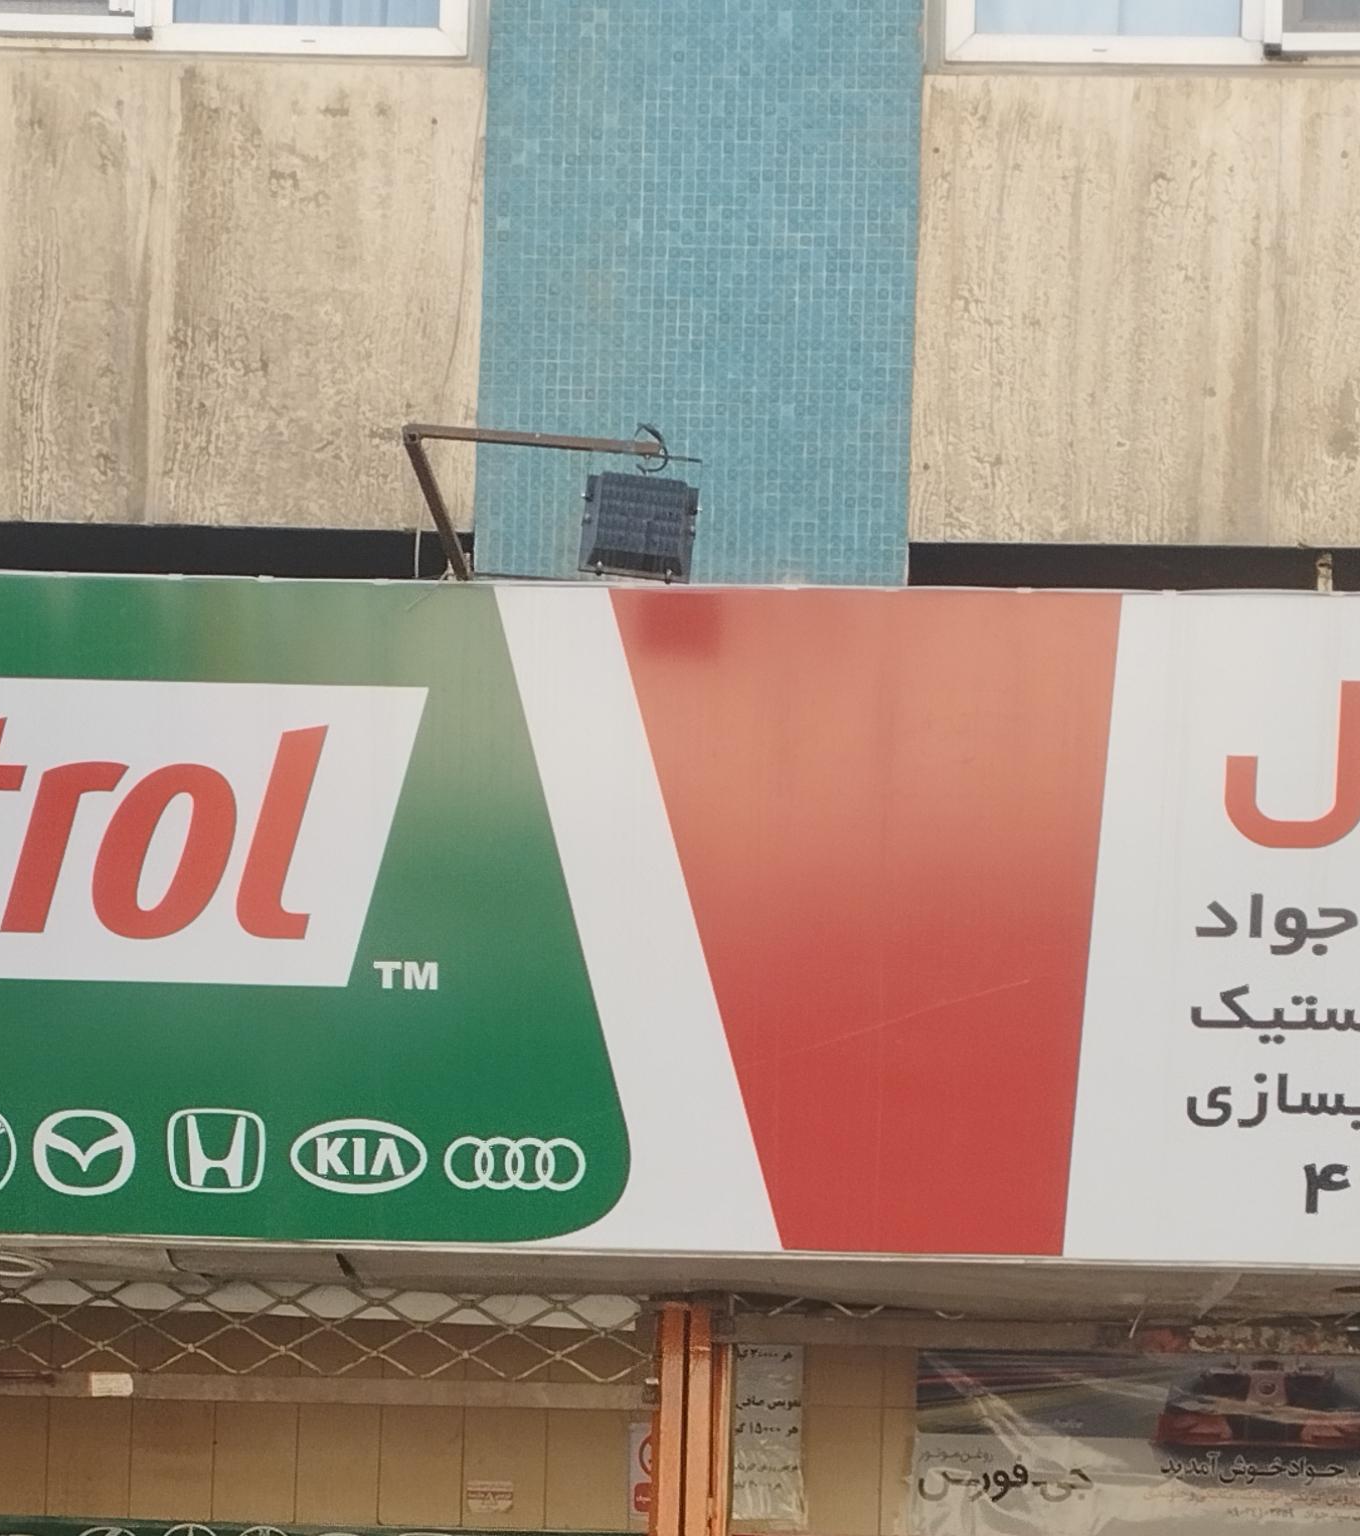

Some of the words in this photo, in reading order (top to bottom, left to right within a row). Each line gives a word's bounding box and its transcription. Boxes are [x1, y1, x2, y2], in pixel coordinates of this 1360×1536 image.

[1195, 893, 1358, 956] جواد
[373, 959, 439, 991] TM
[315, 1137, 406, 1176] KIA
